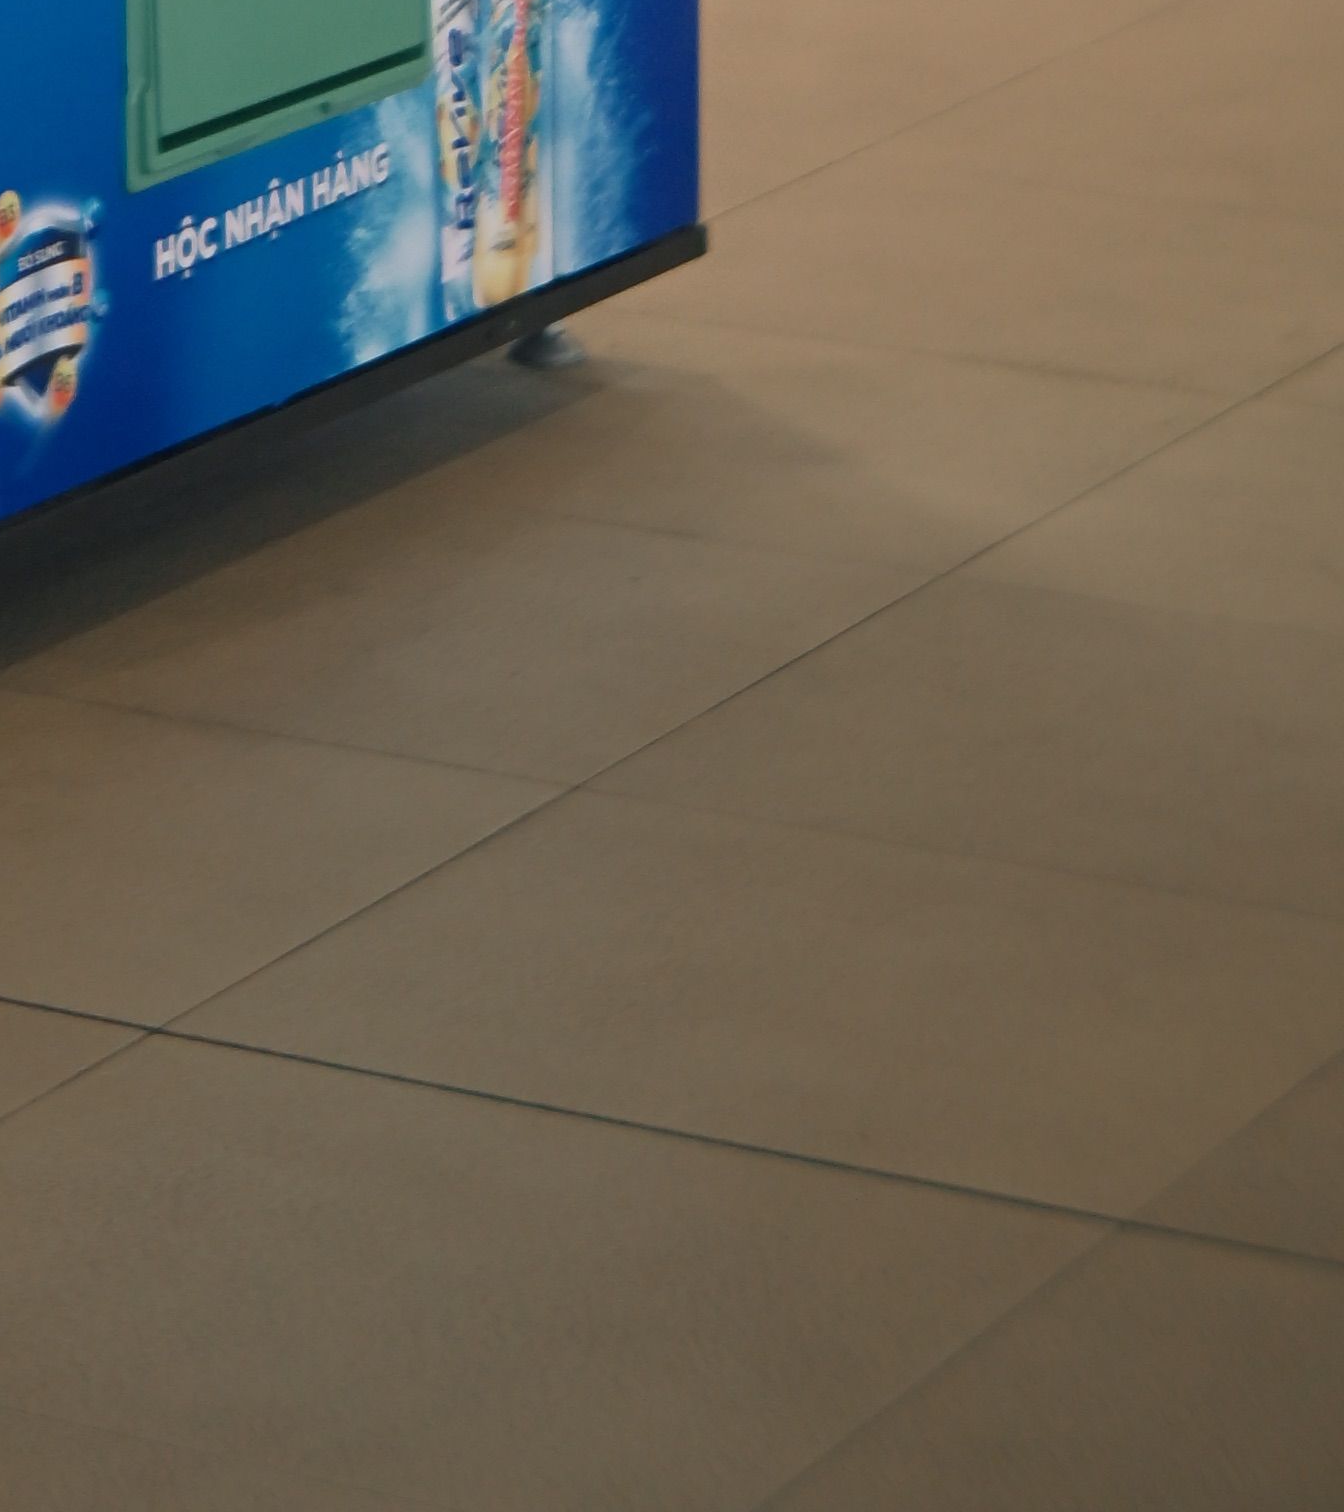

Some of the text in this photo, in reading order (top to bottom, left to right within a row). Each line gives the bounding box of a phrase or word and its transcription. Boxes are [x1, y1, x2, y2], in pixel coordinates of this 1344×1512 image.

[154, 141, 392, 280] HỘC NHẬN HÀNG
